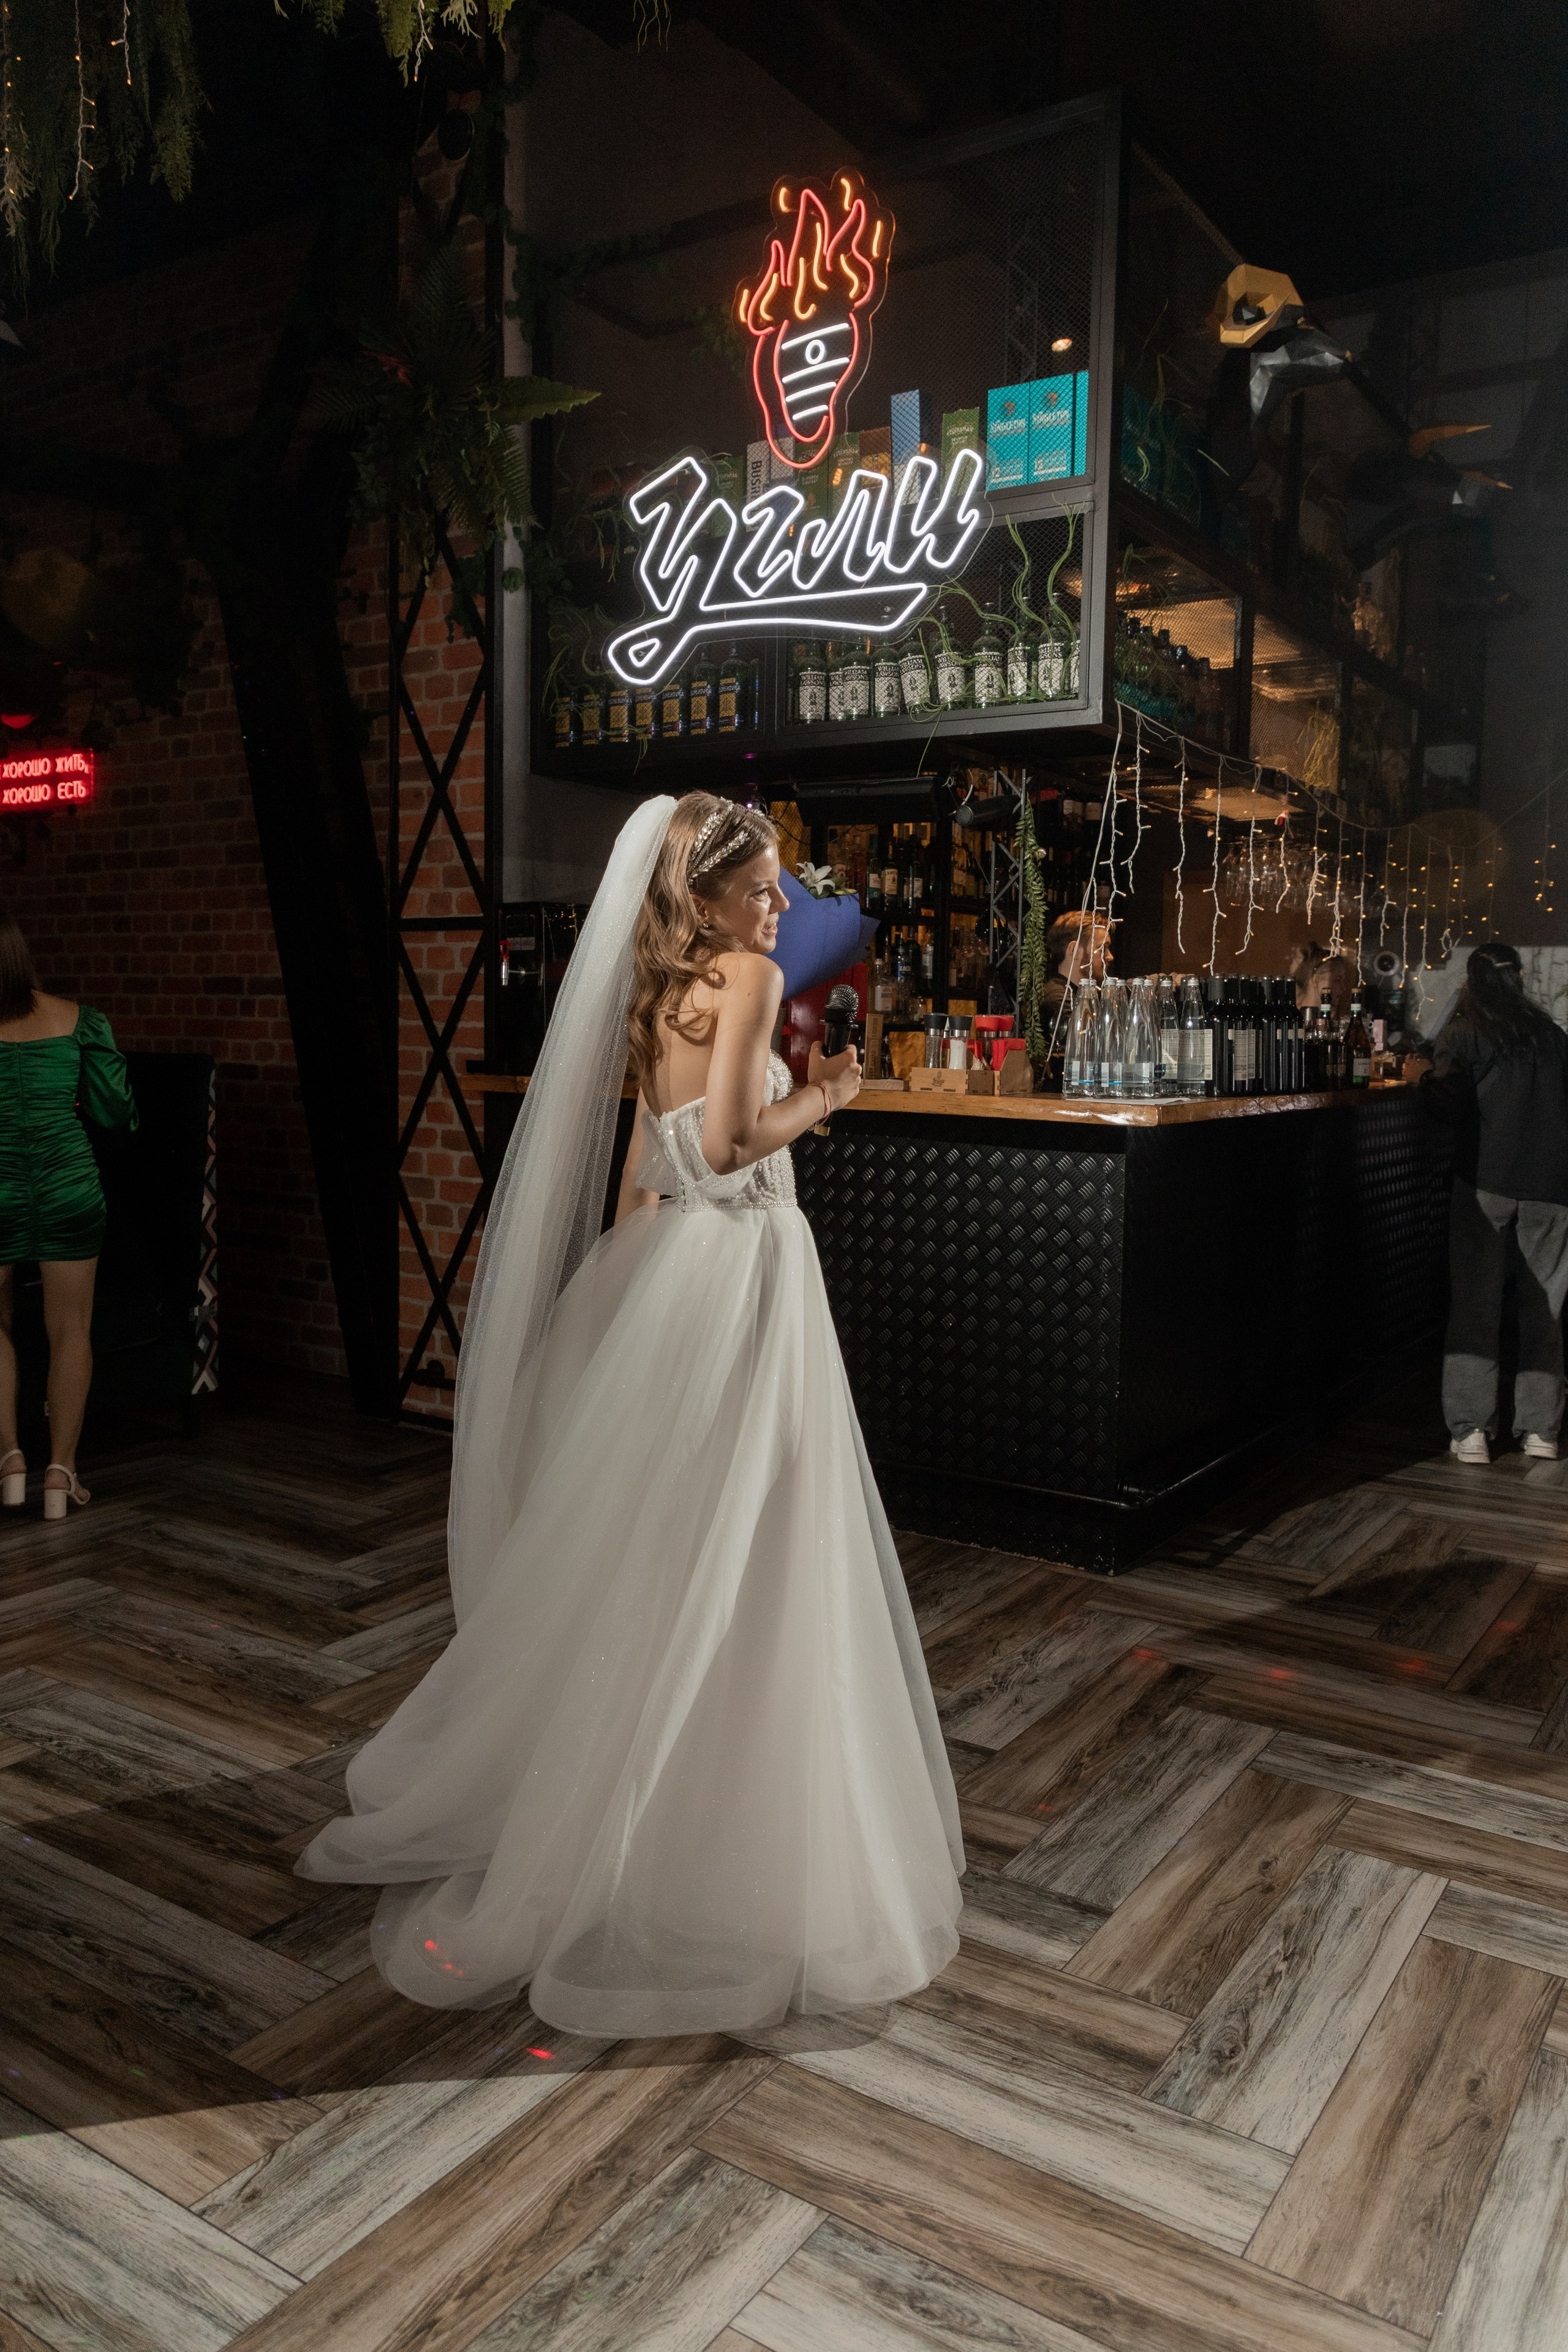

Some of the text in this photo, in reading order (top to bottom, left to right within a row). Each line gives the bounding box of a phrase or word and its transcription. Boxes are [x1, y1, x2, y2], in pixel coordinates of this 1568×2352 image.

[1034, 459, 1044, 470] 12
[2, 758, 51, 778] ХОРОШО
[55, 753, 89, 774] ЖИТЬ,
[2, 780, 86, 804] ХОРОШО ЕСТЬ
